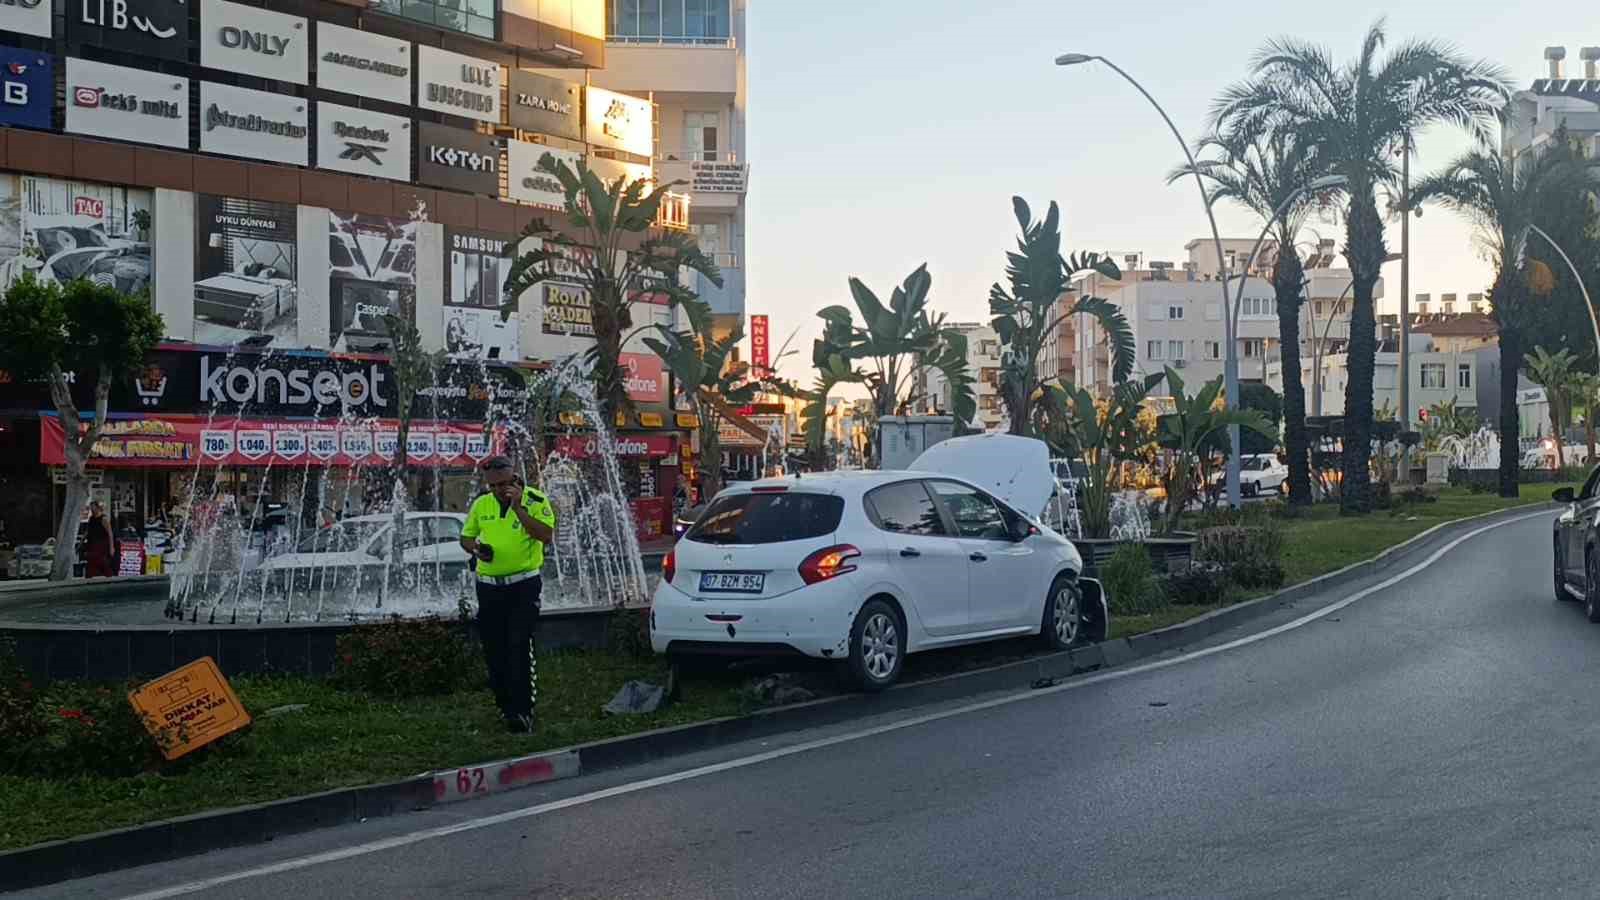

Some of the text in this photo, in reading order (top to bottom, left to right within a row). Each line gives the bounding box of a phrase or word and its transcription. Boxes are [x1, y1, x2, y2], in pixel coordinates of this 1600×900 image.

[219, 26, 291, 57] ONLY
[461, 63, 493, 88] LOVE
[519, 93, 546, 109] ZARA
[430, 144, 494, 173] KOTON
[215, 214, 276, 229] UYKU DÜNYASI
[200, 354, 387, 408] konsept
[705, 575, 761, 588] 07 BZM 954
[456, 768, 487, 794] 62
